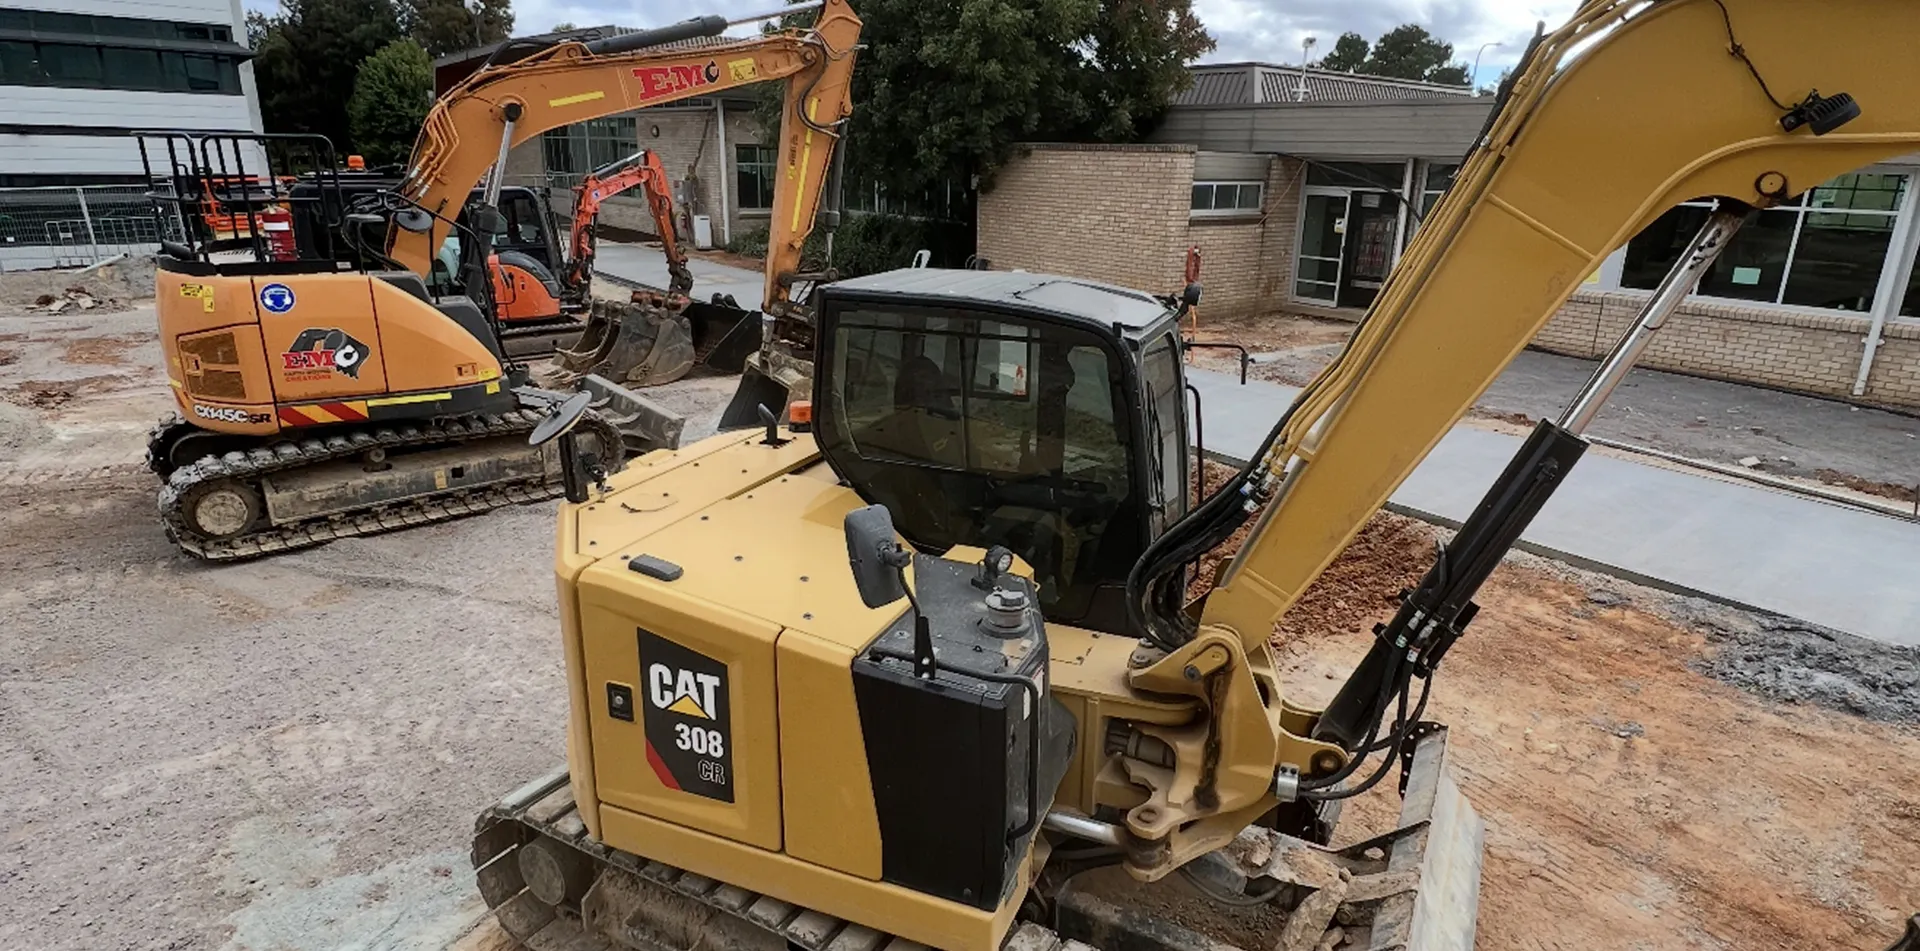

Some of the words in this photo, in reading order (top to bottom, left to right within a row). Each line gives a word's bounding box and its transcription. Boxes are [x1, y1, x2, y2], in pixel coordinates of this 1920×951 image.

[249, 413, 271, 424] SR
[649, 663, 720, 720] CAT
[675, 722, 724, 758] 308
[698, 759, 725, 785] CR
